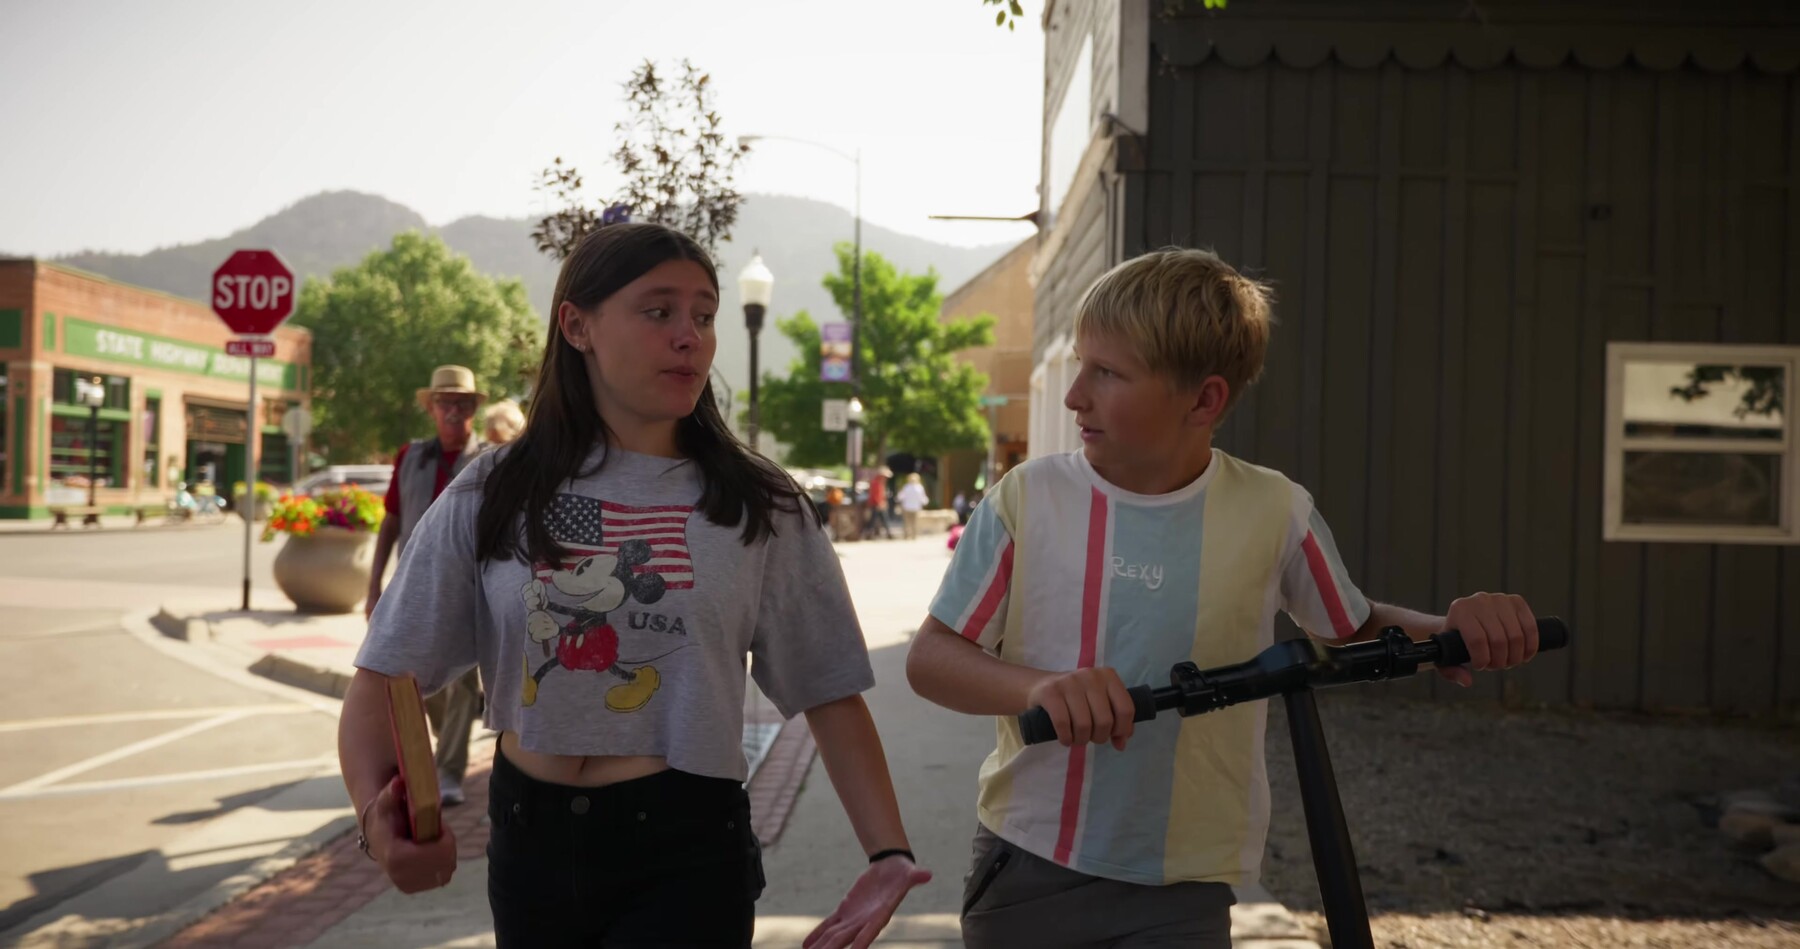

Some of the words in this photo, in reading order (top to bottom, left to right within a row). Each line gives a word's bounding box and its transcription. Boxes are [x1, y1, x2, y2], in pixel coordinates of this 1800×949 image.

[216, 275, 290, 310] STOP
[96, 329, 143, 360] STATE
[628, 610, 687, 636] USA
